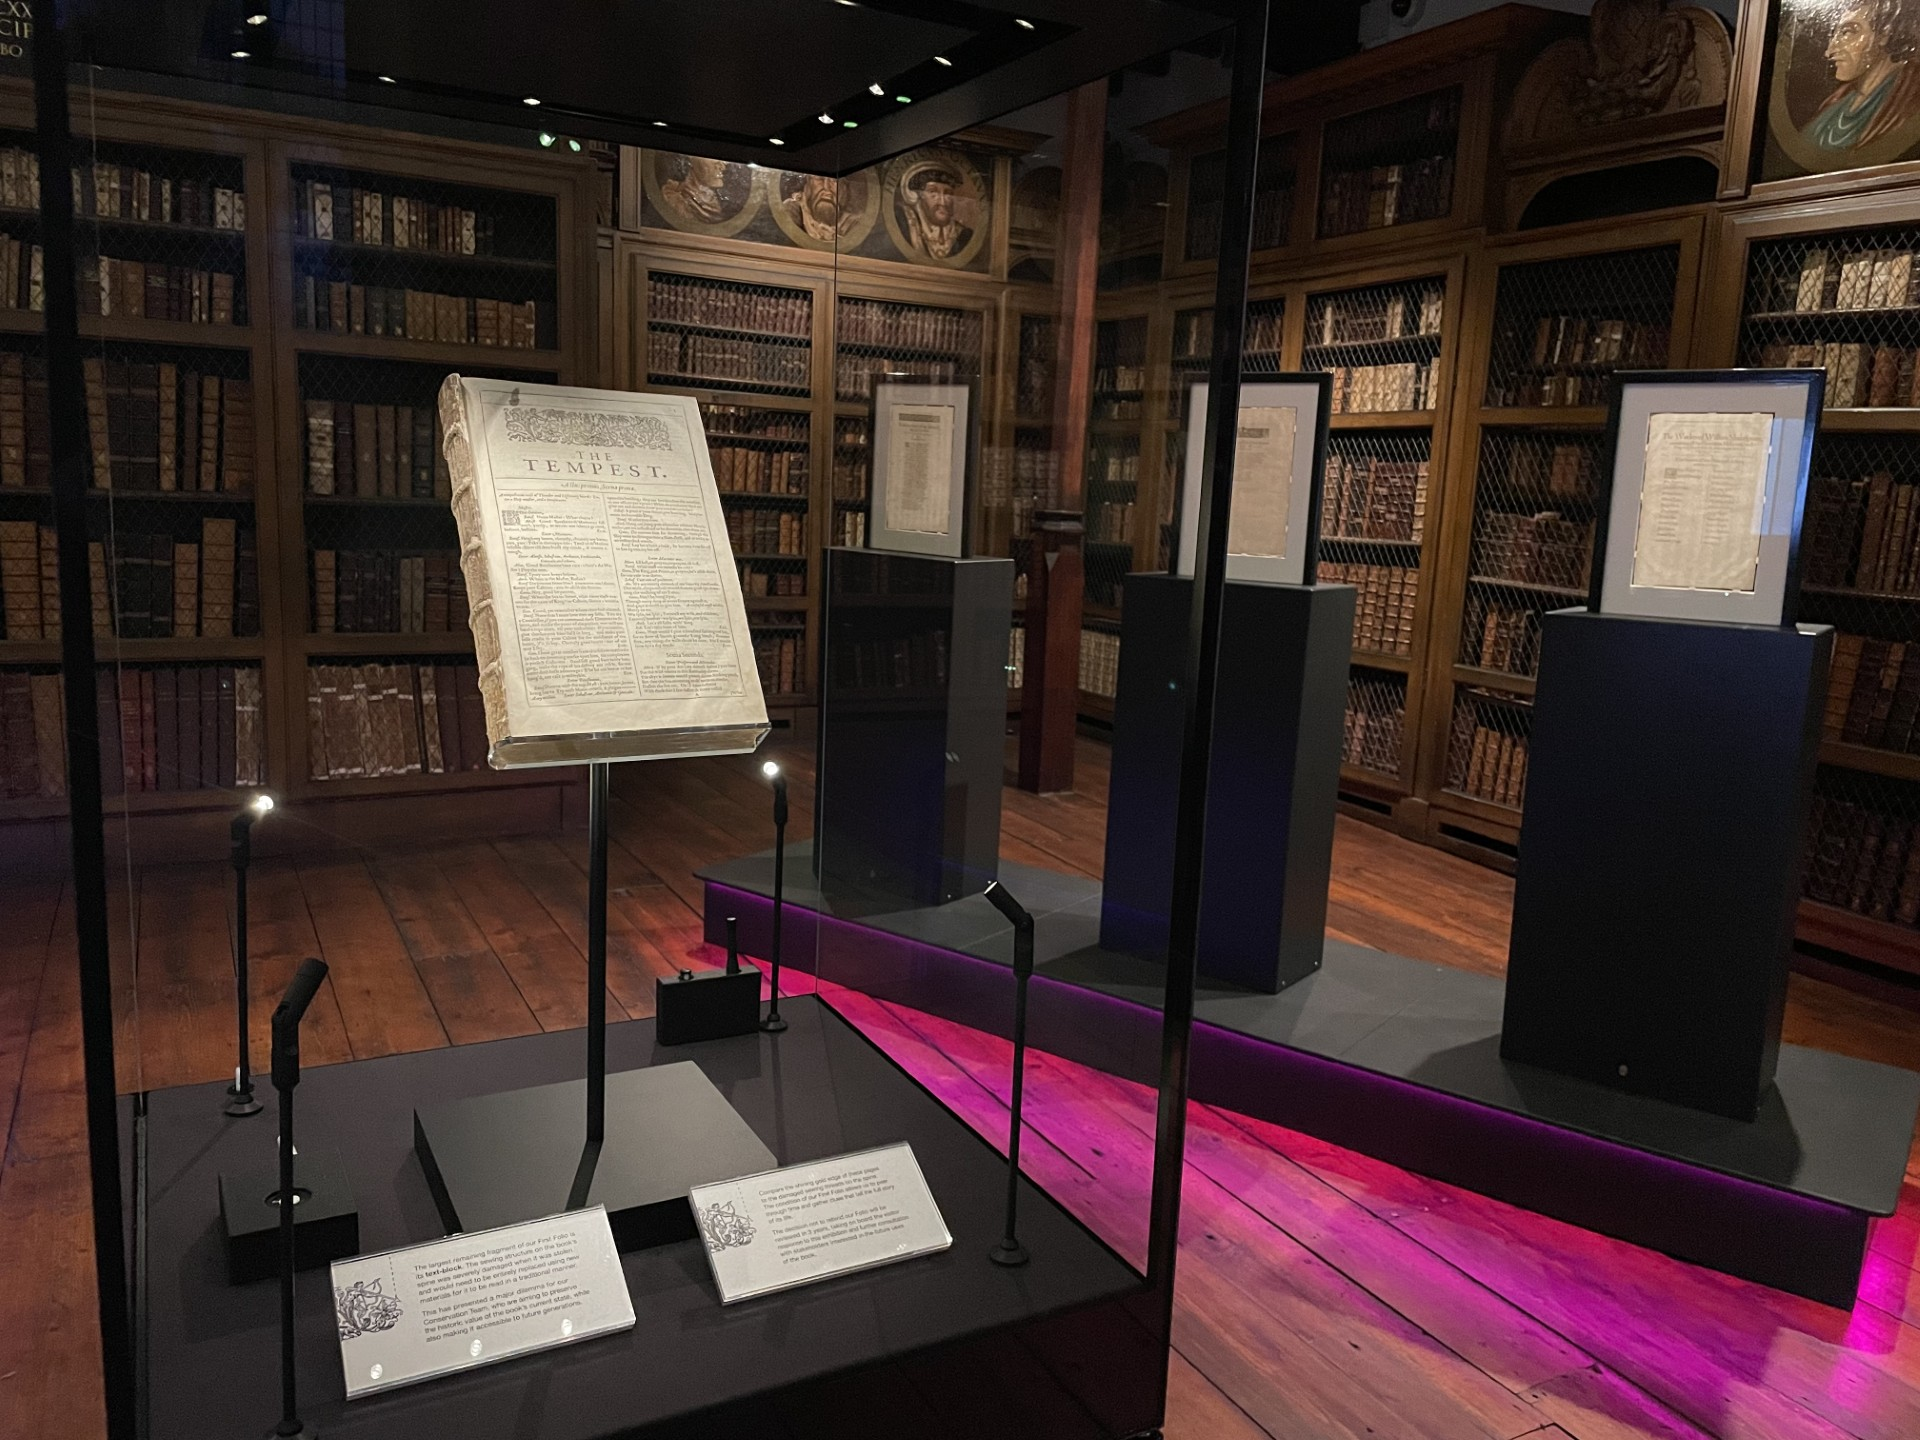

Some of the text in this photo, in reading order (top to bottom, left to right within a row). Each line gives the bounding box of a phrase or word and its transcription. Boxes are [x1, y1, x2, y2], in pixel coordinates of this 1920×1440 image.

[576, 451, 614, 462] THE
[523, 459, 667, 478] TEMPEST.
[759, 1187, 784, 1196] Compare
[779, 1189, 804, 1199] damaged
[766, 1207, 787, 1216] through
[812, 1199, 828, 1207] gather
[776, 1198, 800, 1206] condition
[774, 1232, 801, 1242] reviewed
[822, 1230, 848, 1239] exhibition
[831, 1234, 857, 1245] interested
[429, 1259, 451, 1268] largest
[453, 1252, 485, 1262] remaining
[487, 1245, 515, 1255] fragment
[480, 1256, 503, 1265] sewing
[505, 1250, 533, 1259] structure
[433, 1283, 453, 1292] would
[493, 1270, 516, 1278] entirely
[518, 1262, 546, 1272] replaced
[452, 1269, 479, 1279] severely
[482, 1261, 512, 1272] damaged
[420, 1293, 451, 1303] materials
[519, 1269, 550, 1280] traditional
[424, 1311, 468, 1325] Conservation
[519, 1294, 540, 1302] aiming
[550, 1285, 577, 1296] preserve
[453, 1297, 487, 1310] presented
[517, 1284, 545, 1294] dilemma
[438, 1321, 463, 1330] historic
[529, 1299, 552, 1308] current
[443, 1328, 468, 1338] making
[476, 1318, 511, 1330] accessible
[522, 1311, 541, 1319] future
